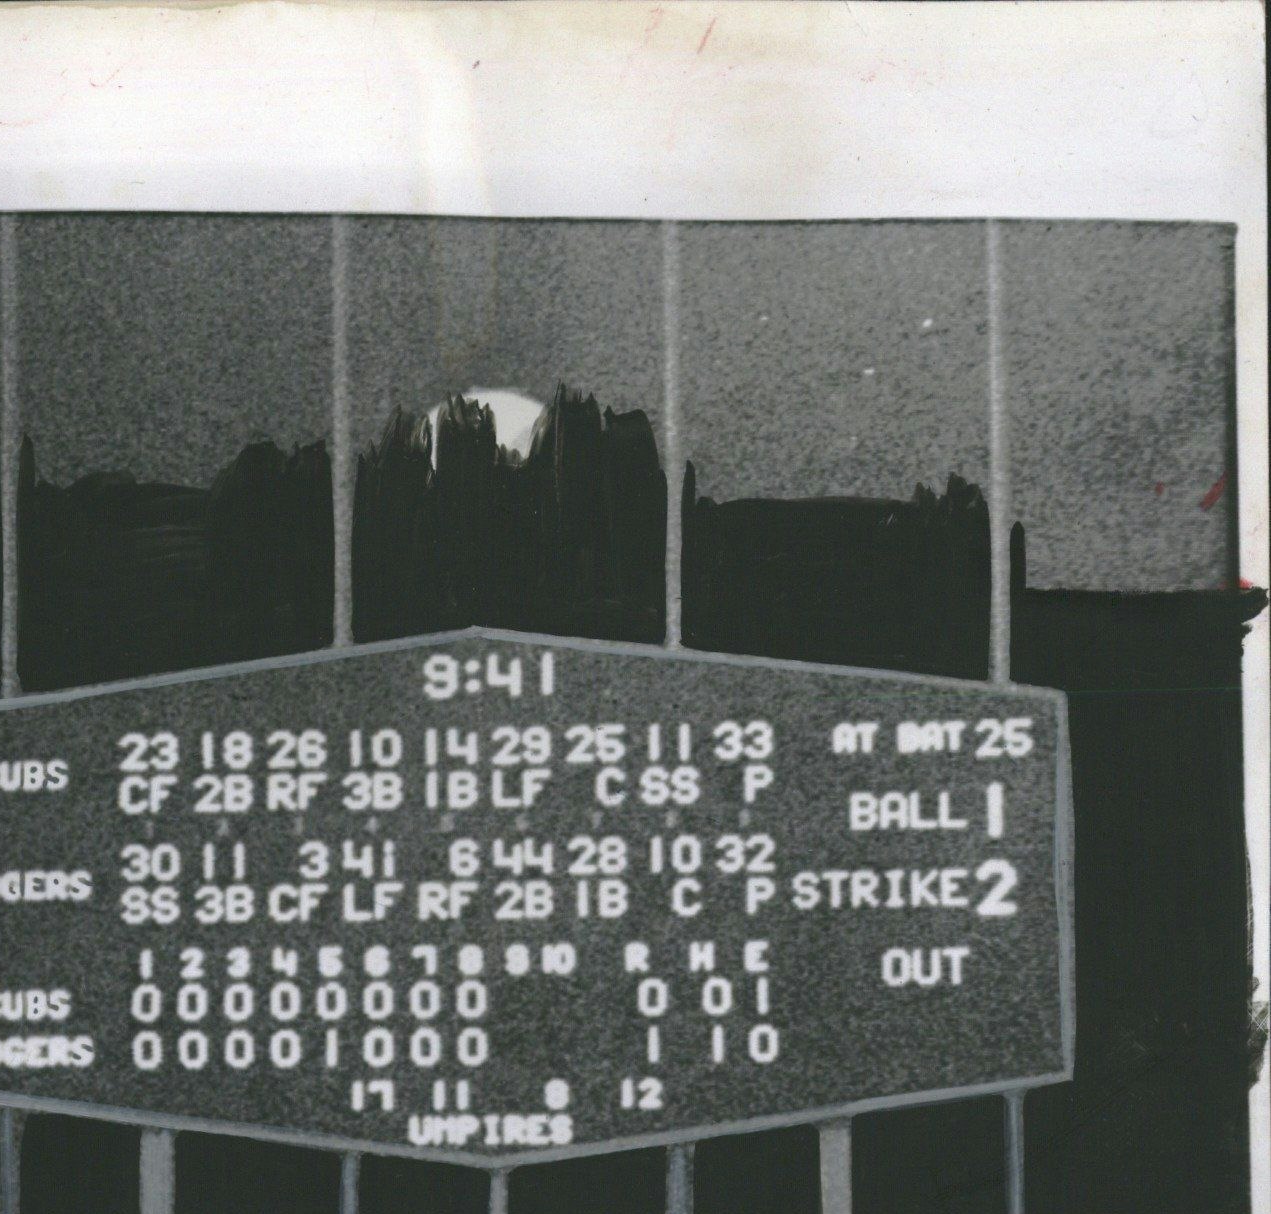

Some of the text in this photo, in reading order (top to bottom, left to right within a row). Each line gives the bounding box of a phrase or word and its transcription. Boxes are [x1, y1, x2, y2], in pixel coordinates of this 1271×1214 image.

[423, 651, 555, 700] 9:41
[118, 720, 774, 772] 23 18 26 10 14 29 25 11 33
[832, 717, 1034, 758] AT BAT 25
[118, 764, 774, 815] CF 2B RF 3B 1B LF C SS P
[849, 782, 1004, 838] BALL 1
[121, 833, 775, 882] 30 11 3 41 6 44 28 10 32
[120, 876, 776, 925] SS 3B CF LF RF 2B 1B C P
[792, 858, 1018, 917] STRIKE 2
[139, 949, 153, 980] 1
[180, 947, 204, 980] 2
[227, 947, 251, 979] 3
[272, 946, 298, 977] 4
[411, 944, 438, 976] 7
[541, 942, 576, 975] 10
[624, 941, 650, 972] R
[689, 941, 715, 972] H
[744, 940, 769, 973] E
[882, 946, 971, 987] OUT
[131, 976, 769, 1023] 0 0 0 0 0 0 0 0 0 0 1
[132, 1024, 779, 1070] 0 0 0 0 1 0 0 0 1 1 0
[351, 1079, 395, 1112] 17
[433, 1079, 470, 1111] 11
[621, 1077, 663, 1110] 12
[408, 1113, 573, 1146] UMPIRES
